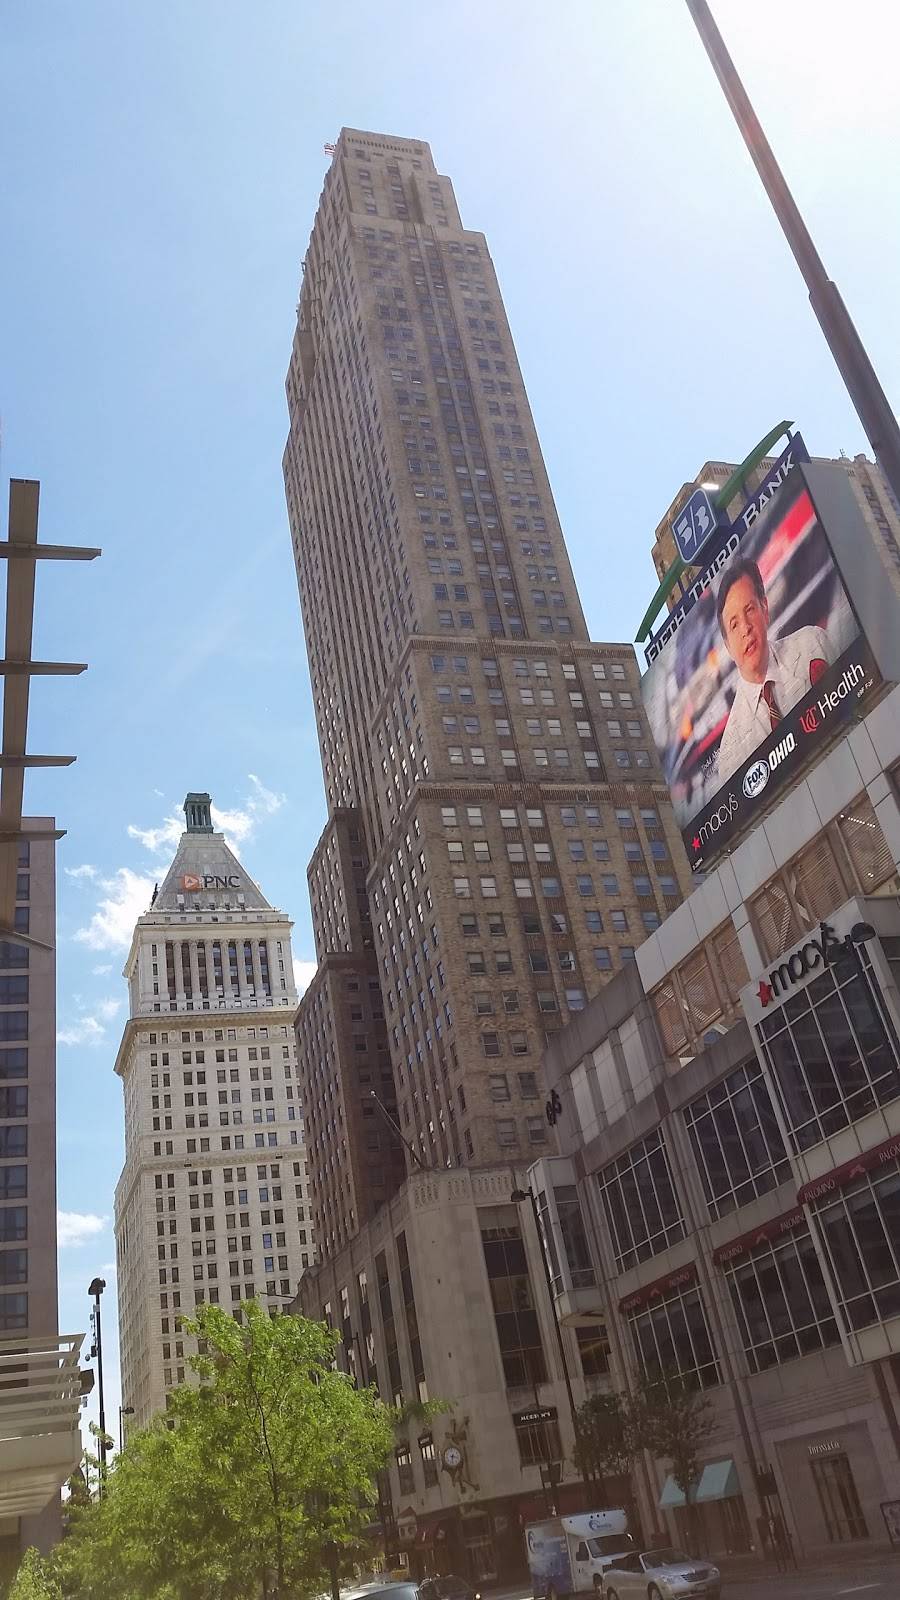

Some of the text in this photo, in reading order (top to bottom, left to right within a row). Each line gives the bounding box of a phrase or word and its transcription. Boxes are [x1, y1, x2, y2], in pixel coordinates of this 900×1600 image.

[645, 451, 794, 664] FIFTH THIRD BANK
[817, 664, 865, 719] Health
[747, 764, 763, 789] FOX
[201, 875, 241, 888] PNC
[804, 1179, 836, 1202] PALOMINO
